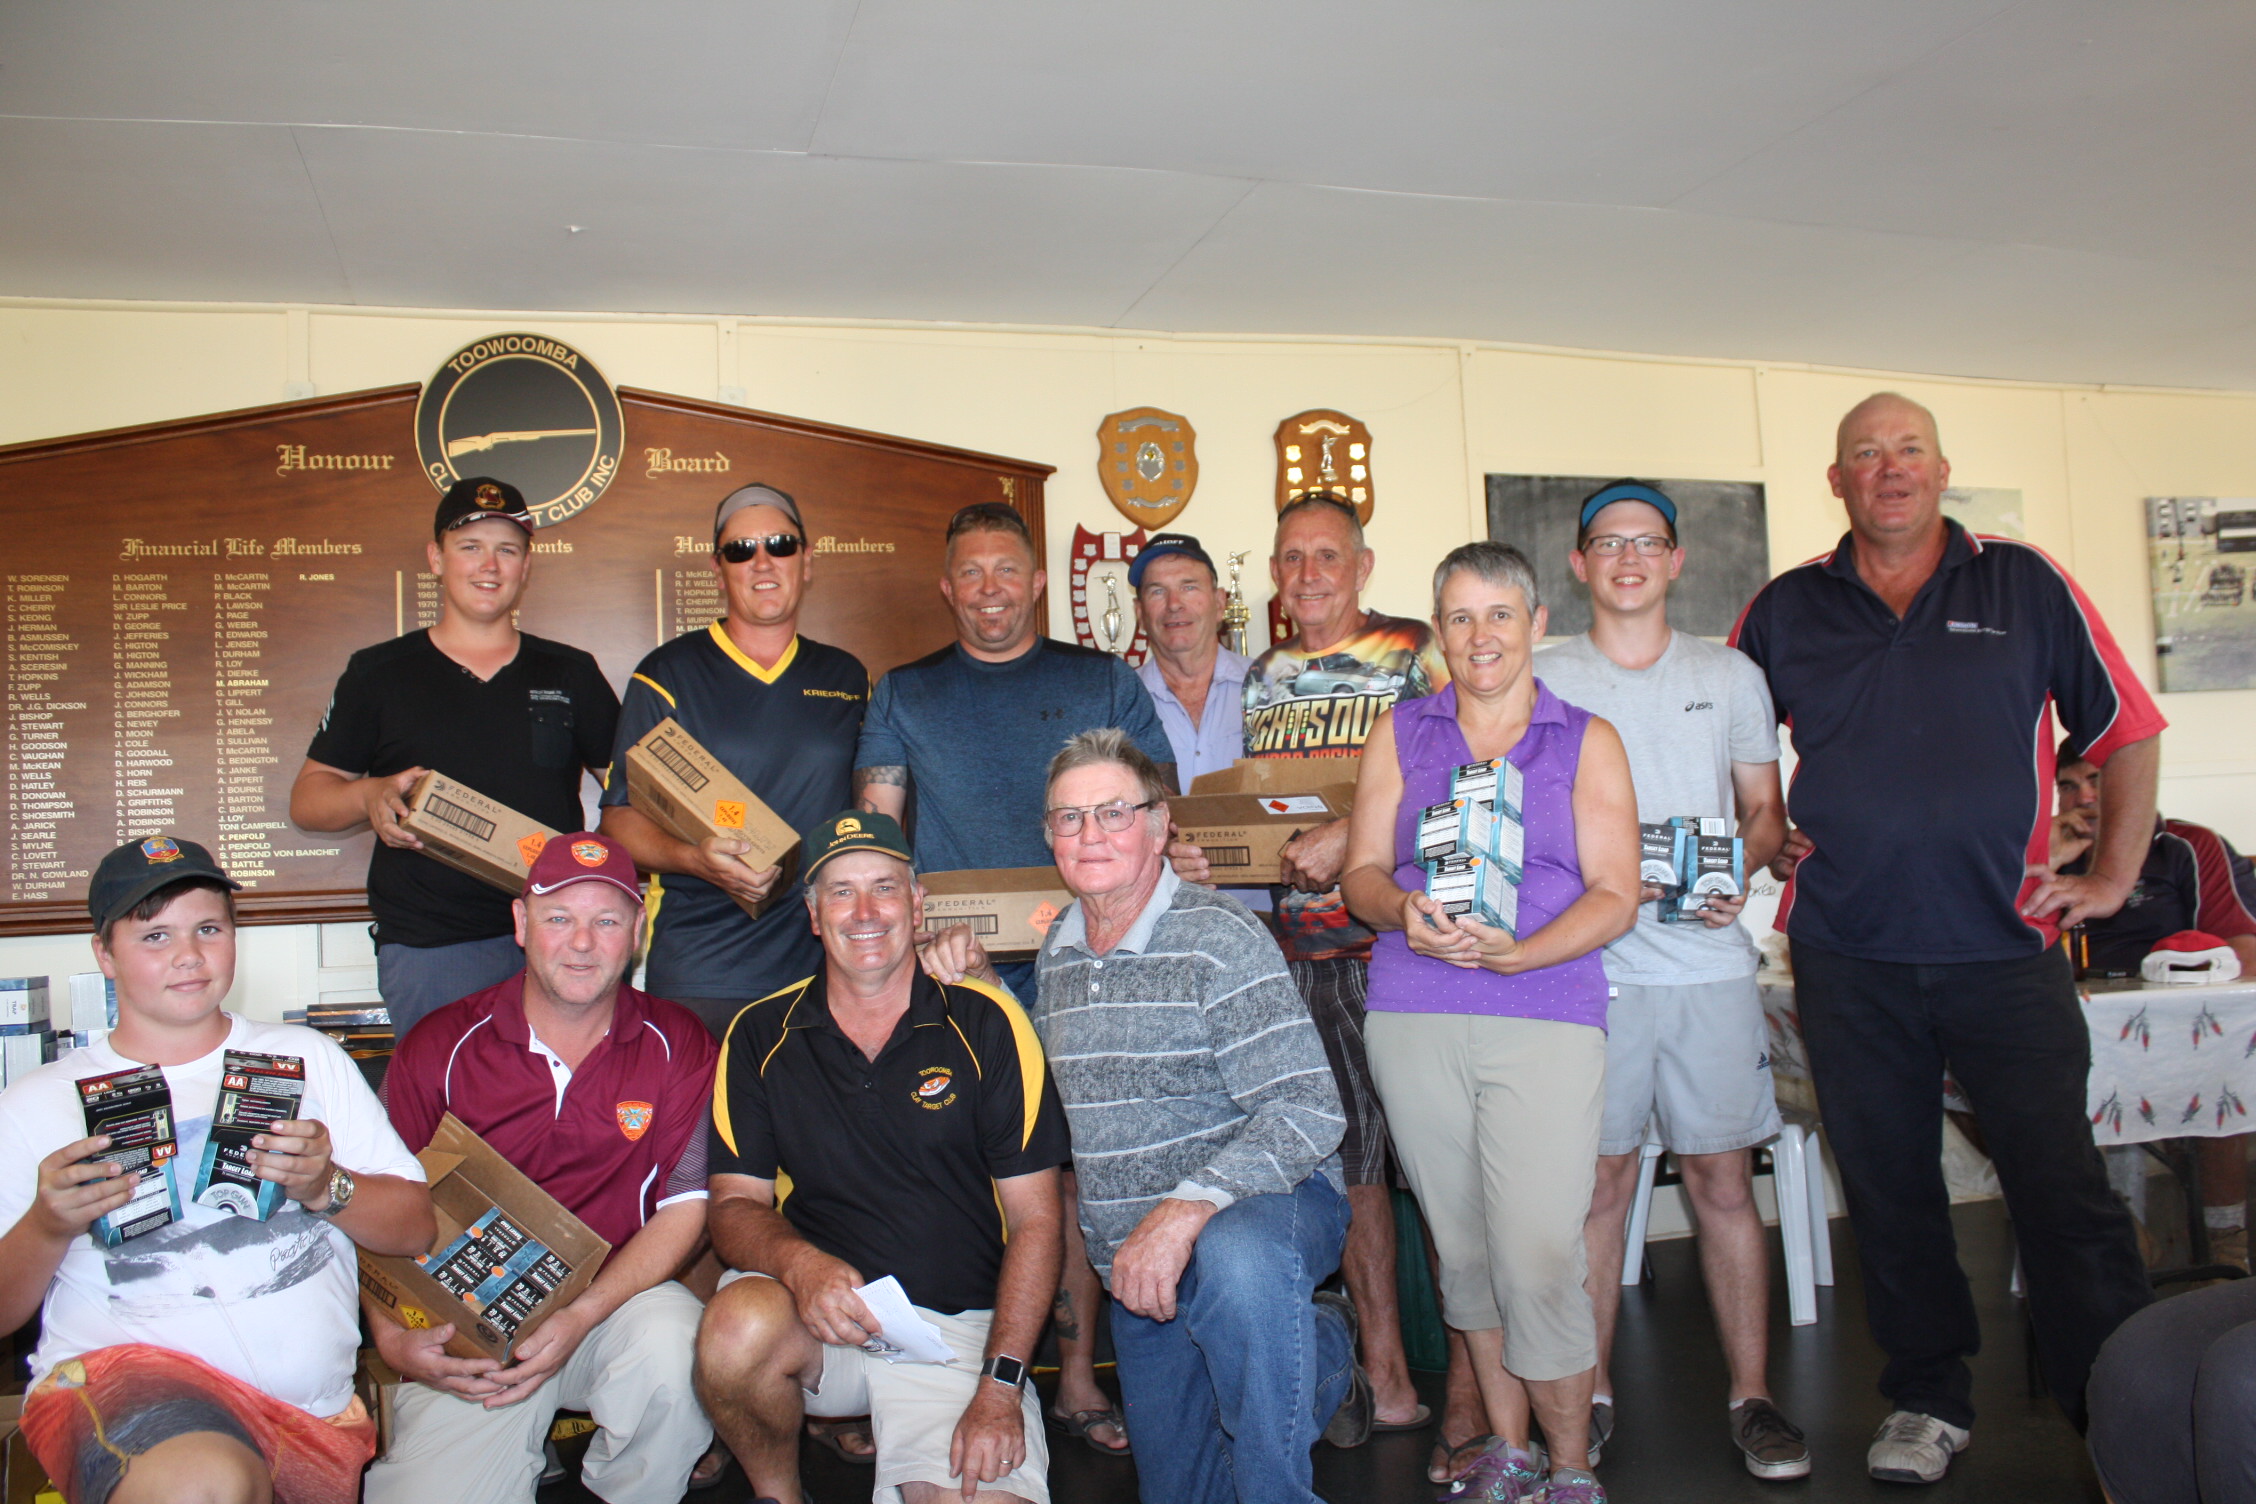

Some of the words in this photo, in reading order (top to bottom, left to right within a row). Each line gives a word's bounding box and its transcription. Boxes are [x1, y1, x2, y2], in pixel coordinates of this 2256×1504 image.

[448, 337, 578, 374] TOOWOOMBA
[276, 444, 394, 477] Honour
[644, 448, 730, 479] Board
[548, 486, 593, 522] CLUB
[590, 454, 614, 488] INC
[119, 538, 218, 562] Financial
[224, 538, 264, 561] Life
[270, 537, 362, 560] Members
[813, 536, 895, 557] Members
[417, 591, 438, 599] 1969
[803, 689, 861, 701] KRIEGHOFF
[1695, 701, 1714, 710] asics
[676, 734, 716, 772] FEDERAL
[448, 785, 498, 813] FEDERAL
[827, 836, 847, 849] JOHN
[938, 899, 992, 909] FEDERAL
[918, 1066, 953, 1077] TOOWOOMBA
[88, 1083, 110, 1093] AA
[228, 1077, 244, 1087] AA
[911, 1091, 922, 1104] CLAY
[922, 1101, 943, 1110] TARGET
[943, 1093, 957, 1106] CLUB
[156, 1145, 172, 1156] AA
[222, 1162, 241, 1173] TARGET
[211, 1189, 229, 1199] TOP
